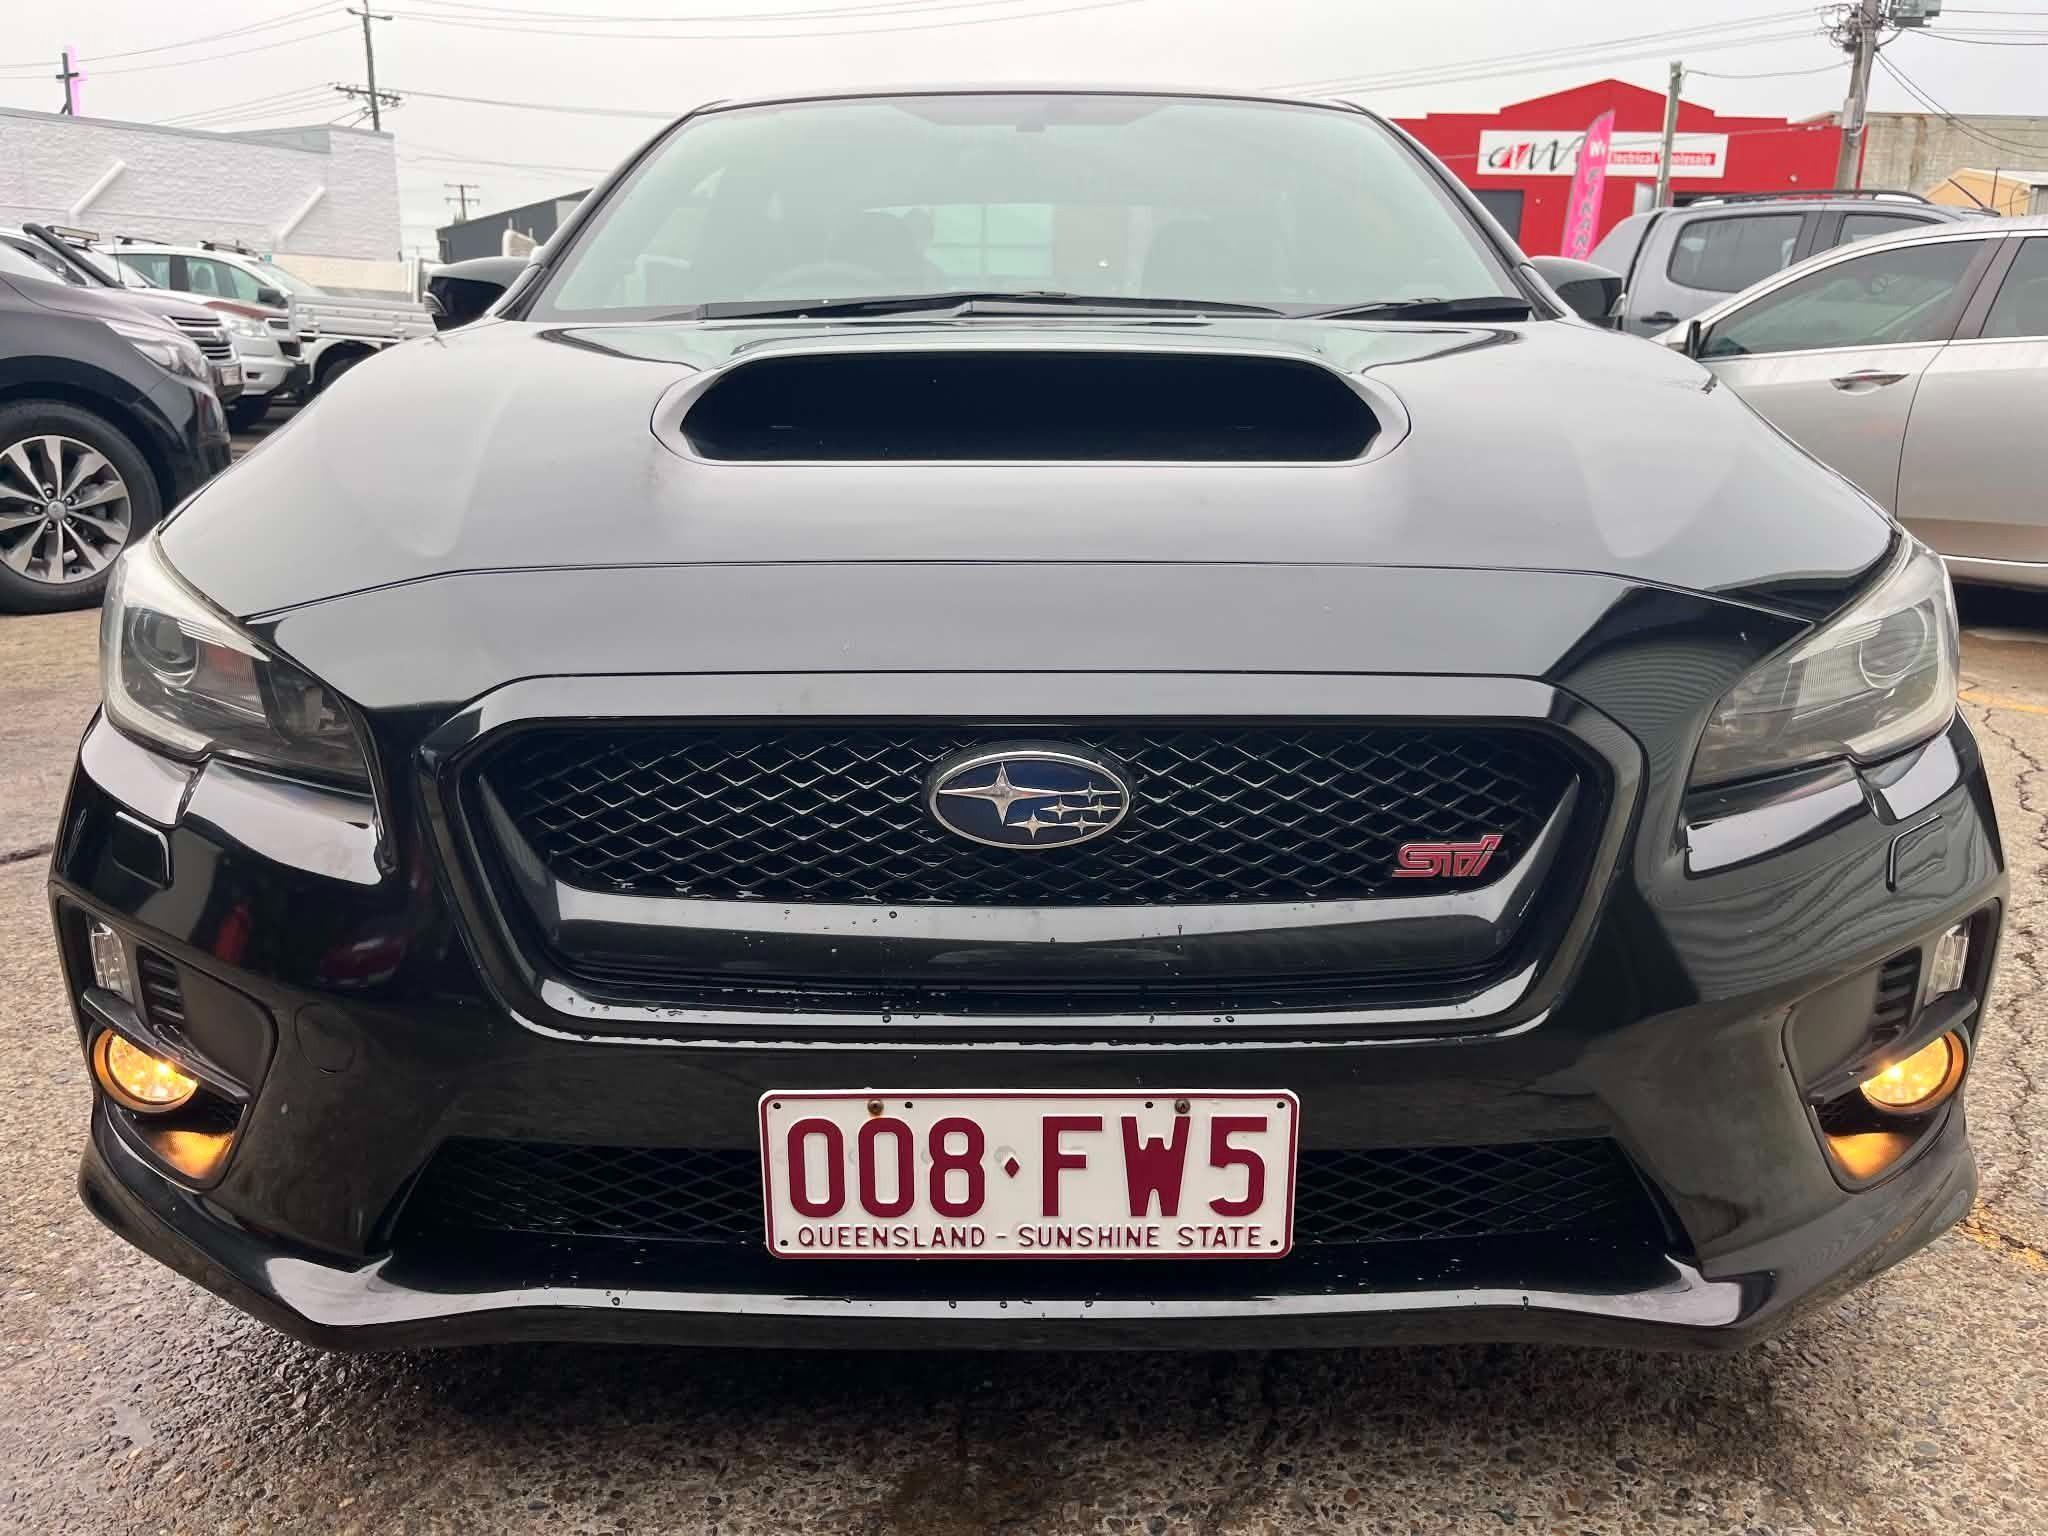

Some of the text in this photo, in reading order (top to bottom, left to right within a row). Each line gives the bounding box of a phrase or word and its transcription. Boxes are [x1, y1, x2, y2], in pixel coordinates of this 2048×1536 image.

[797, 1225, 986, 1248] QUEENSLAND
[1017, 1225, 1160, 1248] SUNSHINE
[1177, 1225, 1262, 1248] STATE
